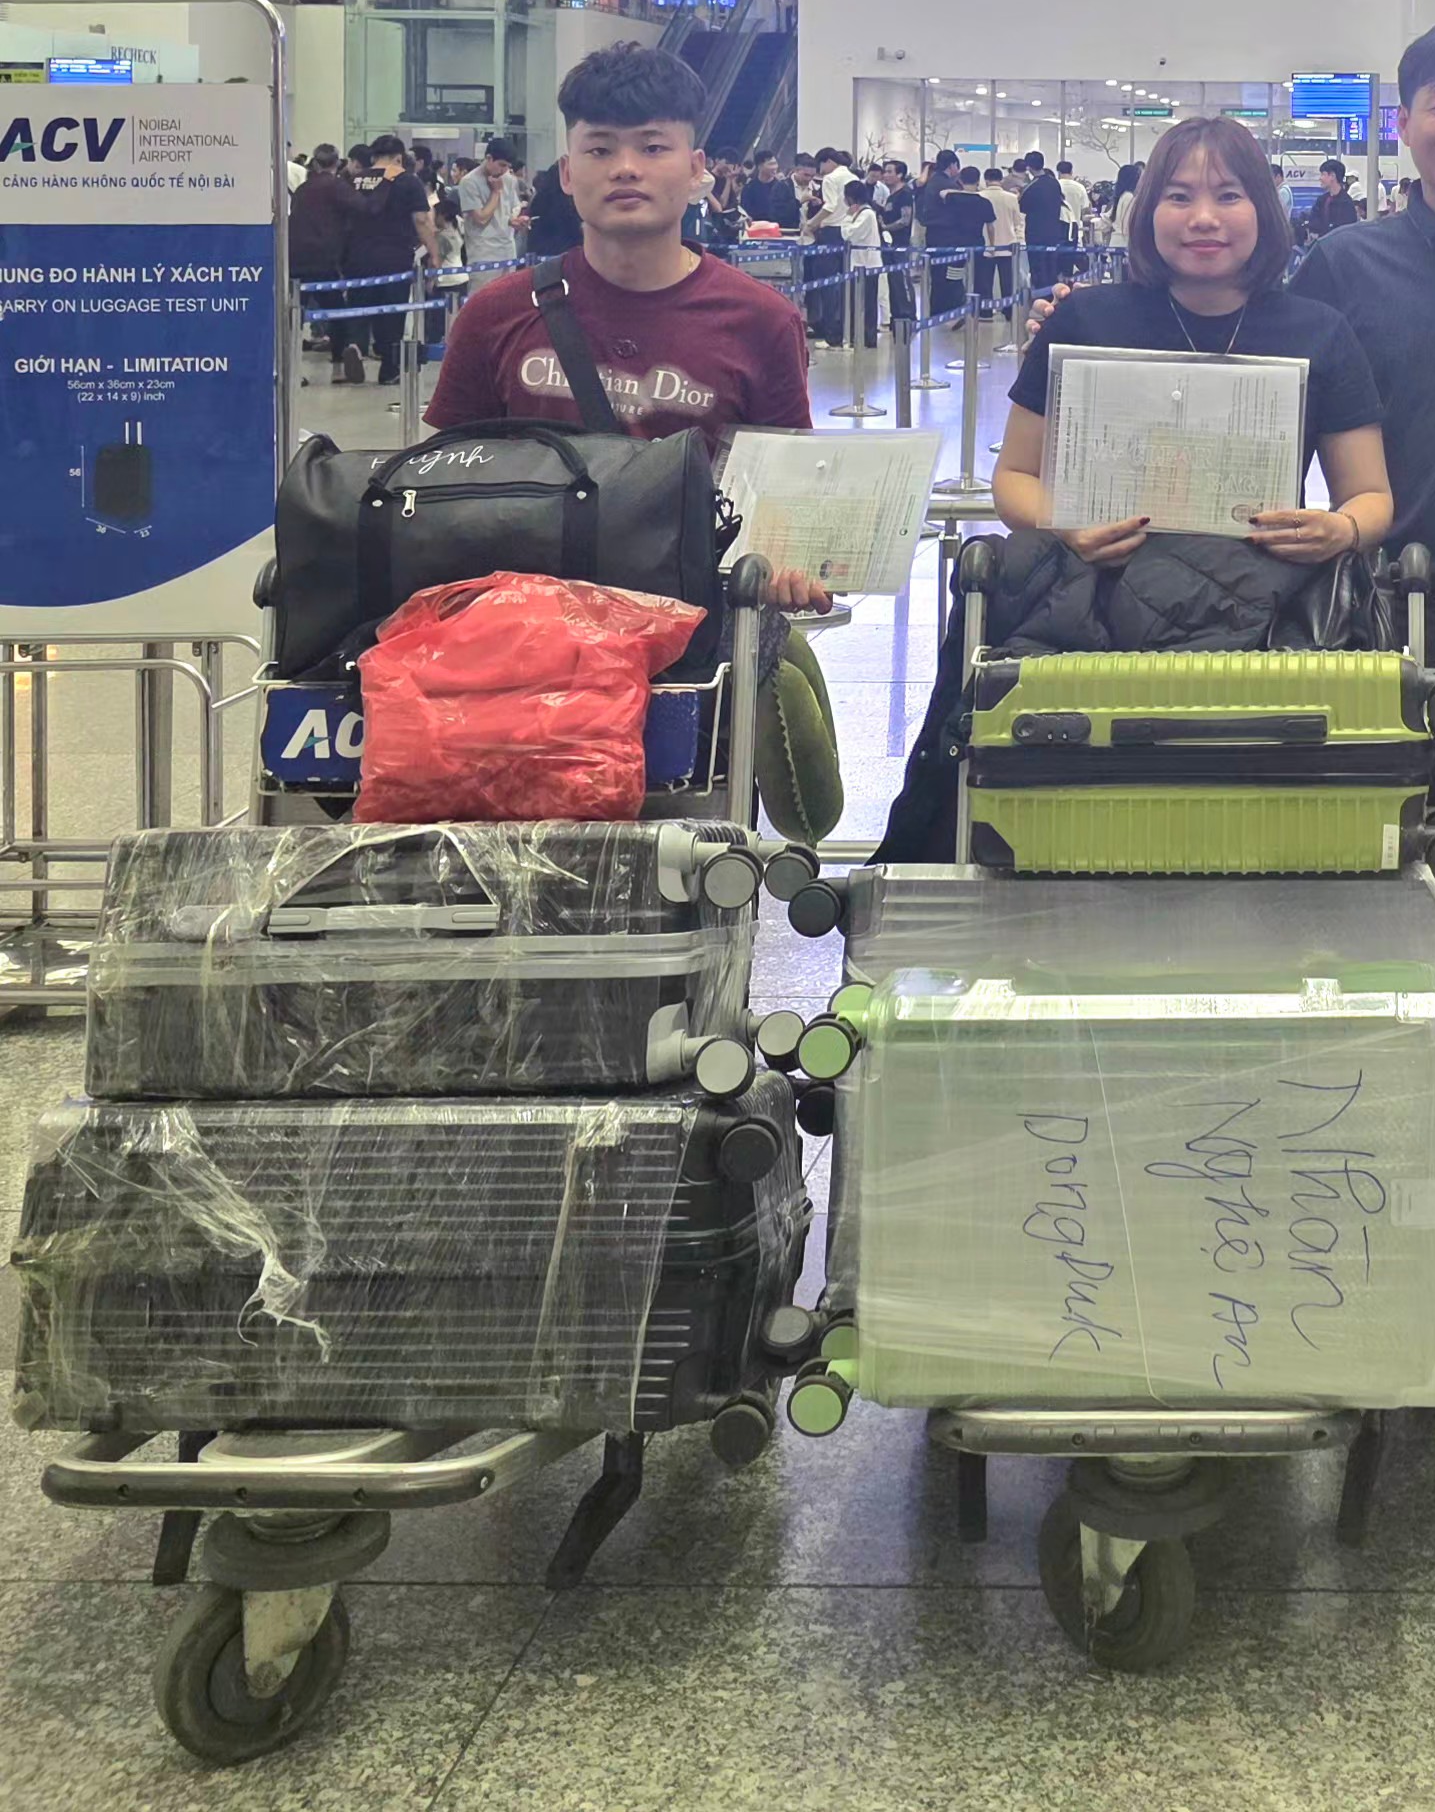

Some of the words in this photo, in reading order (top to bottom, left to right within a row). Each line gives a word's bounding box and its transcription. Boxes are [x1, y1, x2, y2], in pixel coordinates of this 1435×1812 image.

[111, 45, 158, 65] RECHECK
[139, 119, 181, 131] NOIBAI
[0, 117, 126, 162] ACV
[139, 135, 239, 147] INTERNATIONAL
[139, 151, 193, 162] AIRPORT
[3, 172, 38, 188] CẢNG
[42, 173, 78, 188] HÀNG
[82, 173, 127, 188] KHÔNG
[131, 171, 165, 188] QUỐC
[169, 171, 184, 188] TẾ
[189, 174, 210, 191] NỘI
[214, 173, 235, 188] BÀI
[1286, 170, 1306, 179] ACV
[0, 268, 44, 283] UNG
[49, 268, 77, 283] ĐO
[83, 264, 136, 283] HÀNH
[142, 263, 165, 282] LÝ
[170, 263, 223, 282] XÁCH
[228, 267, 263, 282] TAY
[52, 299, 75, 312] ON
[81, 299, 160, 312] LUGGAGE
[165, 298, 207, 312] TEST
[211, 298, 249, 312] UNIT
[14, 355, 55, 373] GIỚI
[61, 359, 101, 376] HẠN
[124, 357, 229, 372] LIMITATION
[67, 380, 96, 390] 56cm
[107, 380, 135, 390] 36cm
[147, 380, 175, 390] 23cm
[521, 357, 639, 396] Chian
[650, 369, 714, 408] Dior
[77, 392, 94, 402] (22
[107, 392, 118, 402] 14
[130, 392, 142, 403] 9)
[69, 468, 81, 477] 56
[281, 709, 364, 759] AC
[1145, 1097, 1271, 1273] Nghệ
